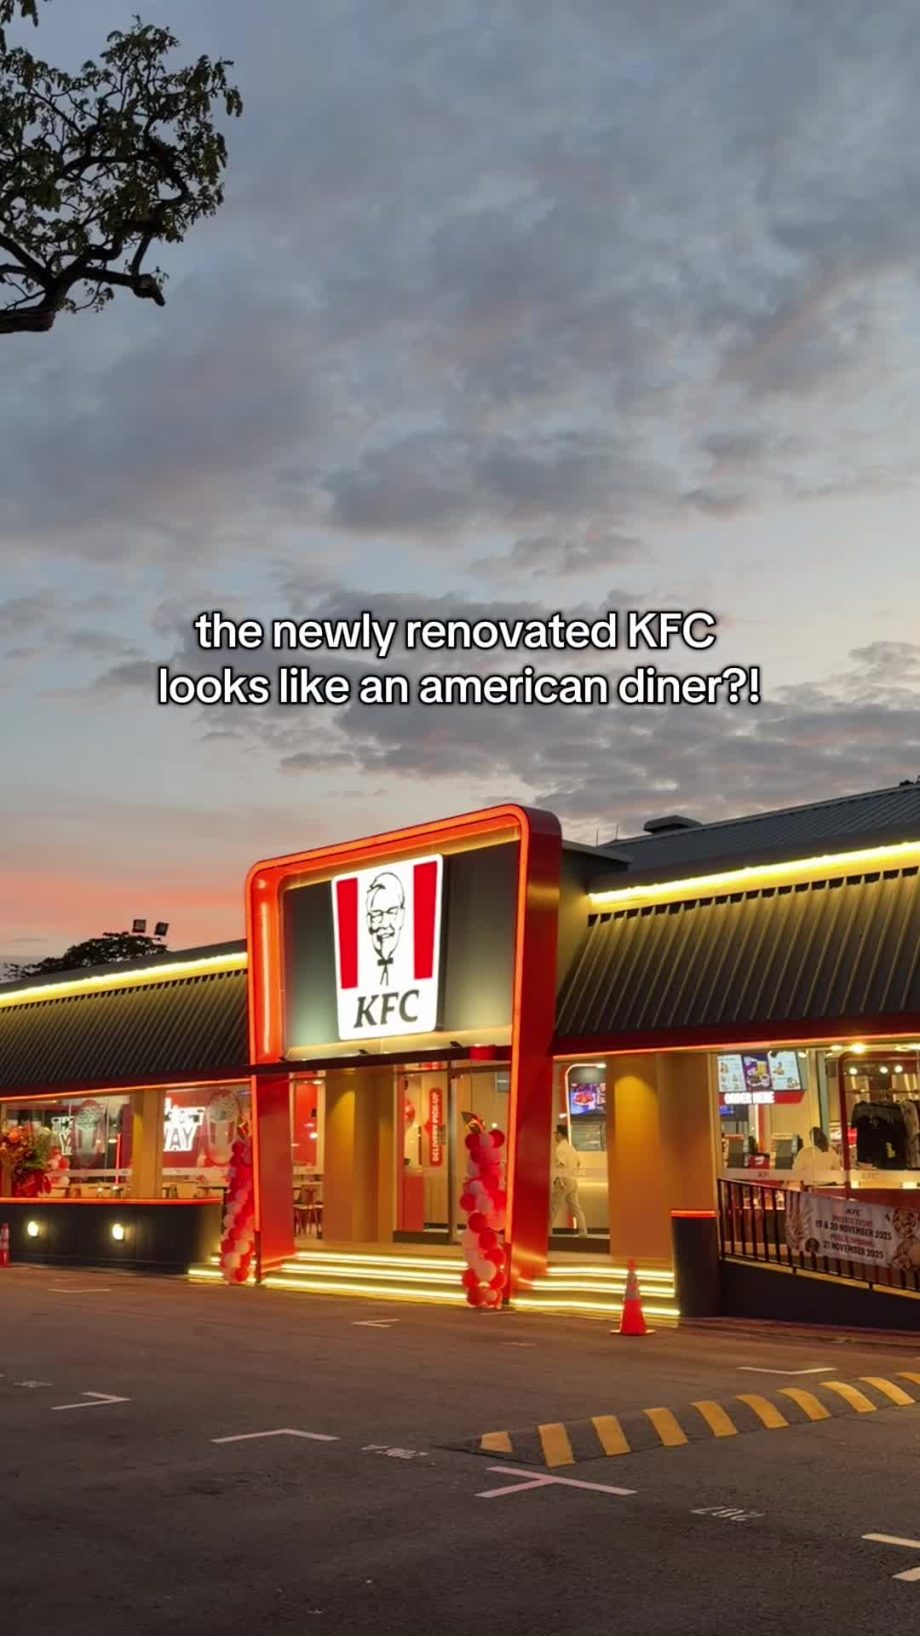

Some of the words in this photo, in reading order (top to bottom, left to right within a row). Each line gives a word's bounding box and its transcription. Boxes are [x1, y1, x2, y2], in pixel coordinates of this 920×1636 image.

[354, 989, 420, 1028] KFC
[846, 1207, 862, 1216] KFC
[840, 1224, 874, 1237] NOVEMBER
[874, 1229, 892, 1241] 2025
[831, 1243, 866, 1256] NOVEMBER
[866, 1248, 884, 1259] 2025
